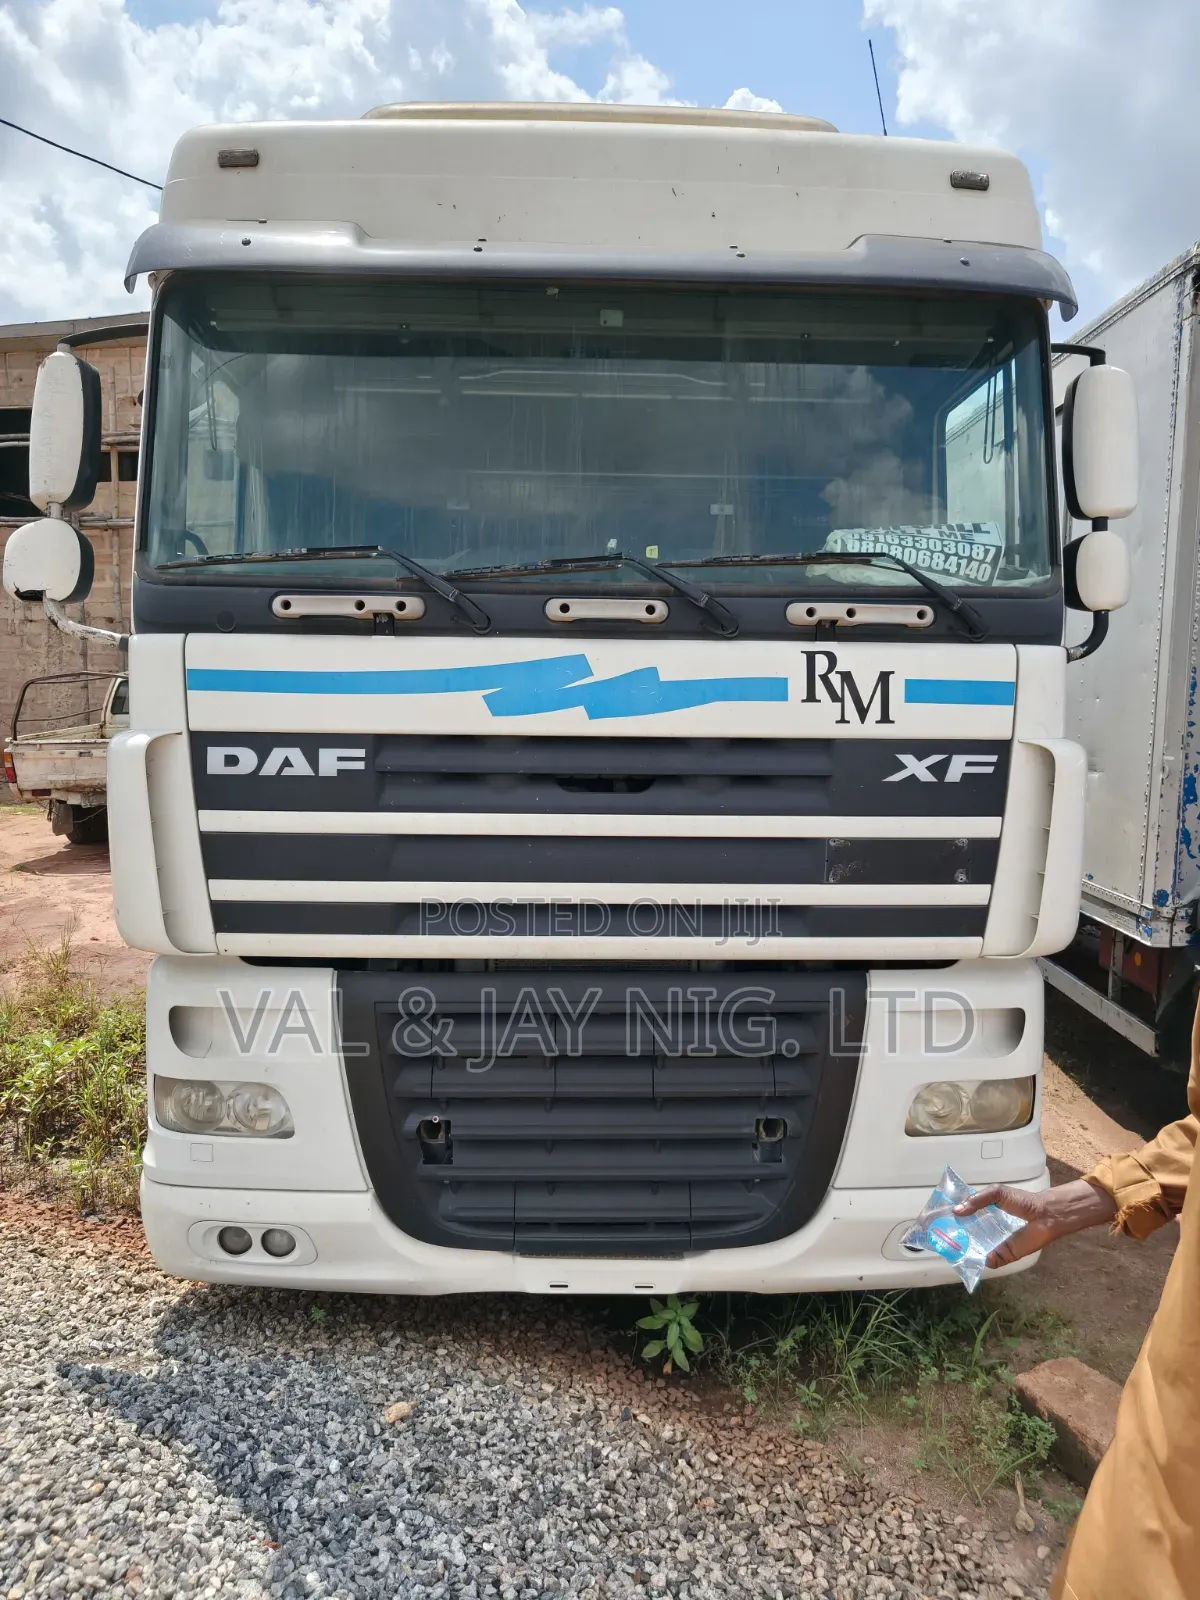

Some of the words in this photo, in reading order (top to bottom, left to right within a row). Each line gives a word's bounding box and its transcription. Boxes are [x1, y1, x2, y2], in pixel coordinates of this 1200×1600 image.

[801, 650, 895, 724] RM
[206, 746, 366, 777] DAF
[881, 754, 998, 783] XF
